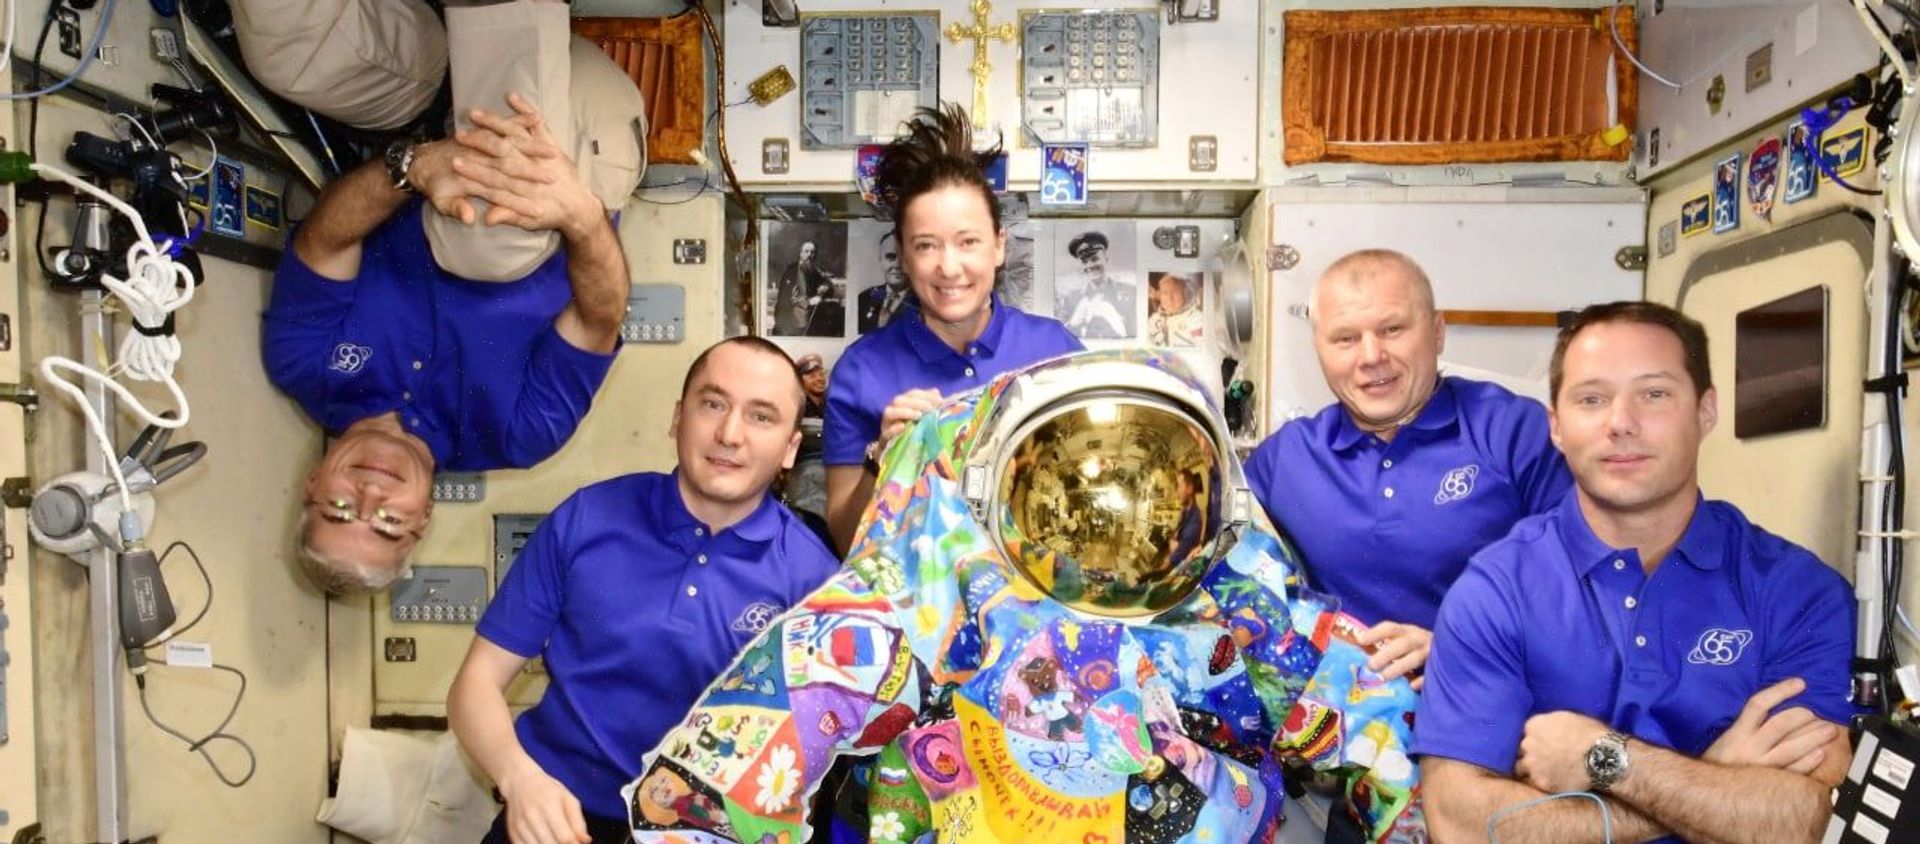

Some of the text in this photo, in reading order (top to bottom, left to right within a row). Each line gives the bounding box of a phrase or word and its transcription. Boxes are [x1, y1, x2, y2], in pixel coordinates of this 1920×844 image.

[1043, 172, 1071, 201] 65
[339, 346, 360, 371] 65
[1444, 471, 1468, 496] 65
[746, 605, 769, 631] 65
[1704, 631, 1735, 662] 65
